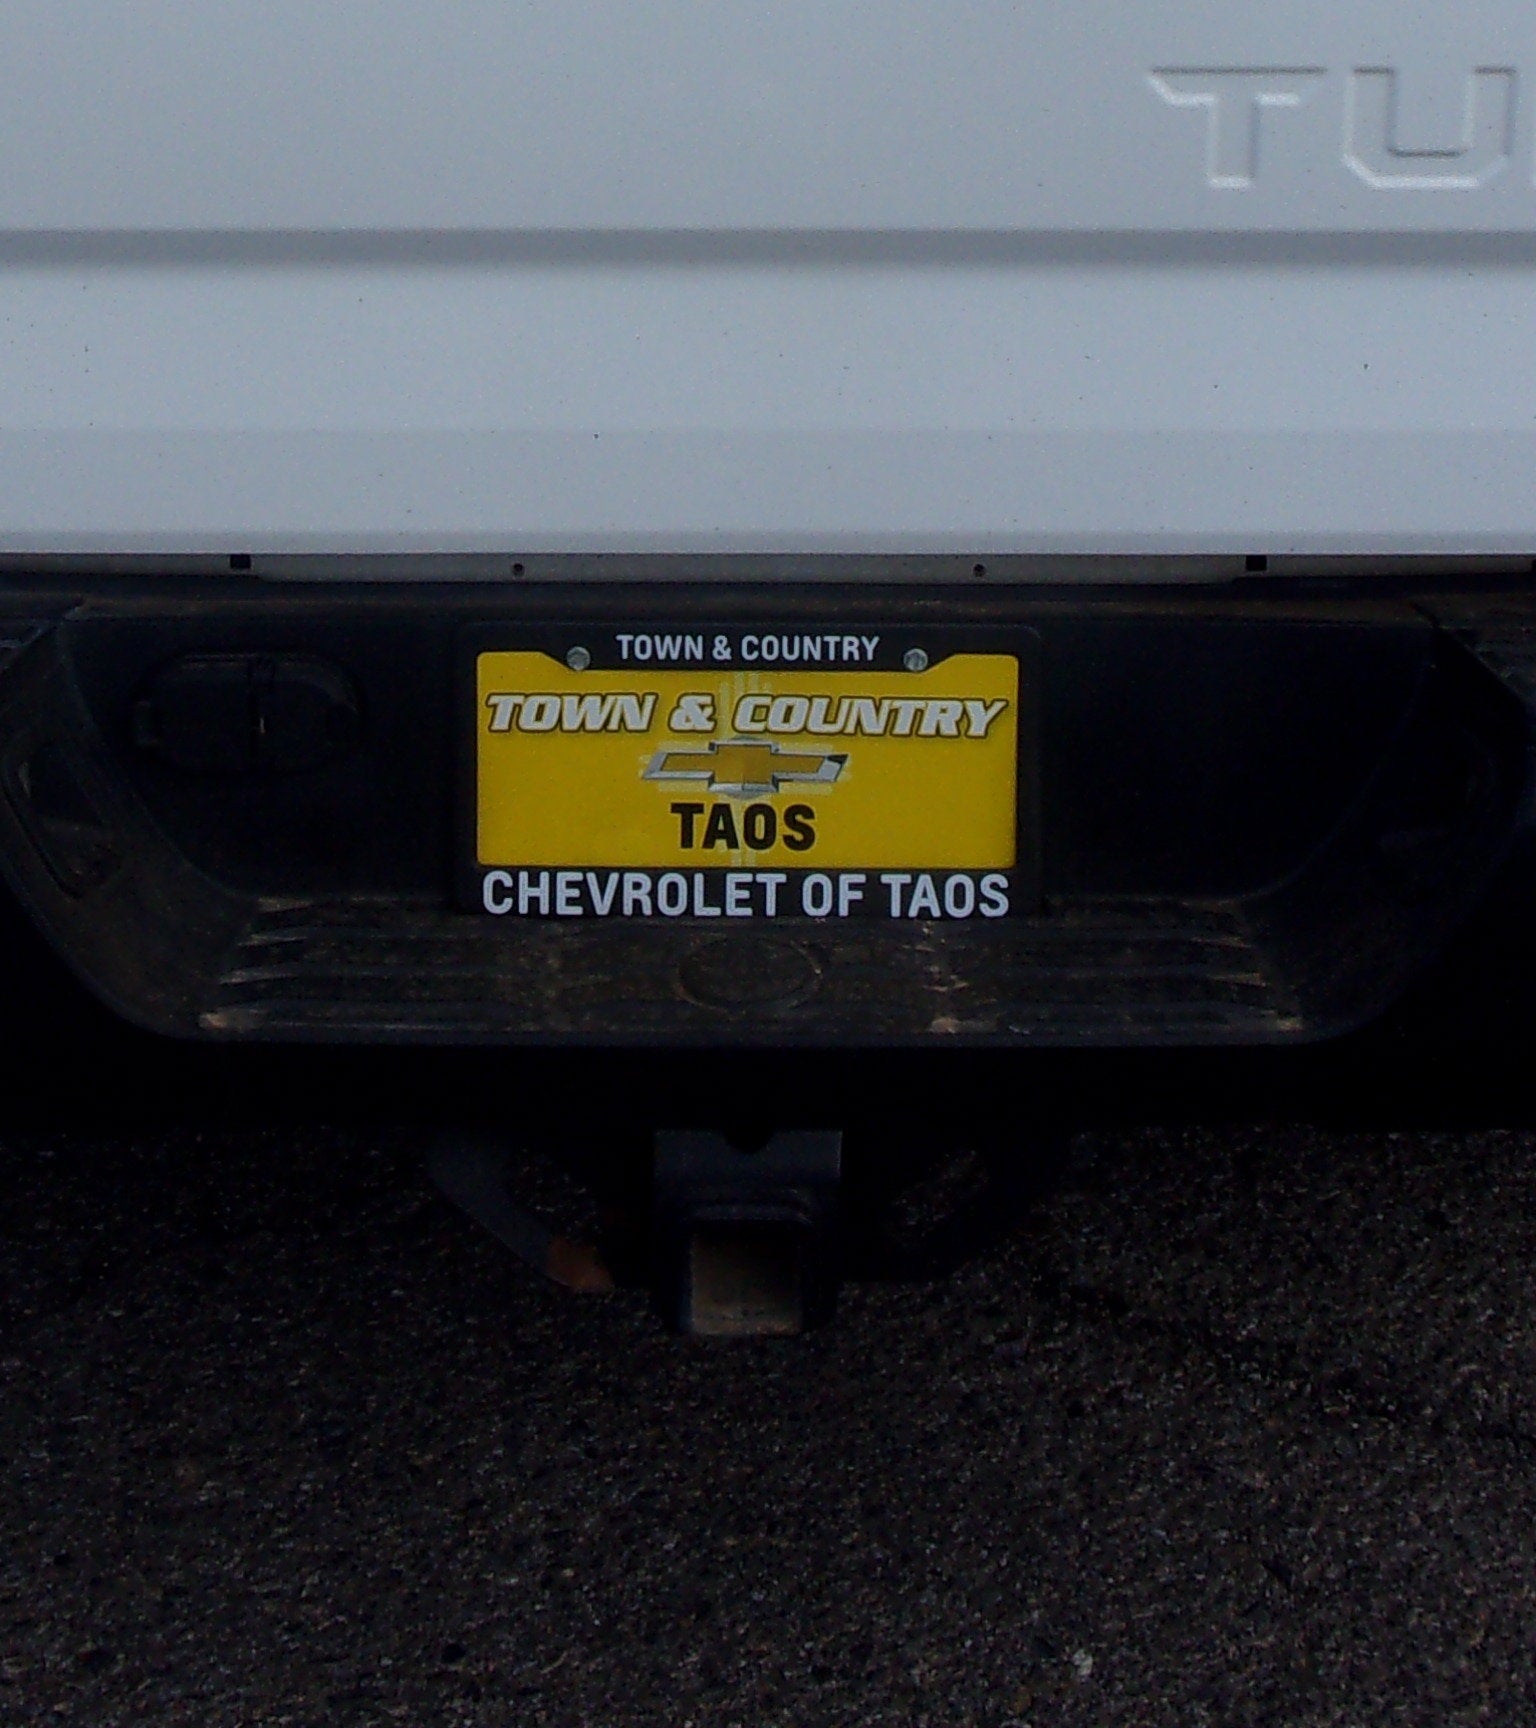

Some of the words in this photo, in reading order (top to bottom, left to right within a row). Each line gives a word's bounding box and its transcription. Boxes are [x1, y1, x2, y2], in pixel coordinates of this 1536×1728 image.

[616, 634, 708, 661] TOWN
[712, 634, 733, 661] &
[740, 634, 881, 663] COUNTRY
[485, 691, 659, 734] TOWN
[668, 692, 716, 735] &
[731, 694, 1010, 740] COUNTRY
[670, 801, 817, 852] TAOS
[482, 869, 787, 919] CHEVROLET
[801, 872, 867, 919] OF
[880, 872, 1011, 920] TAOS
